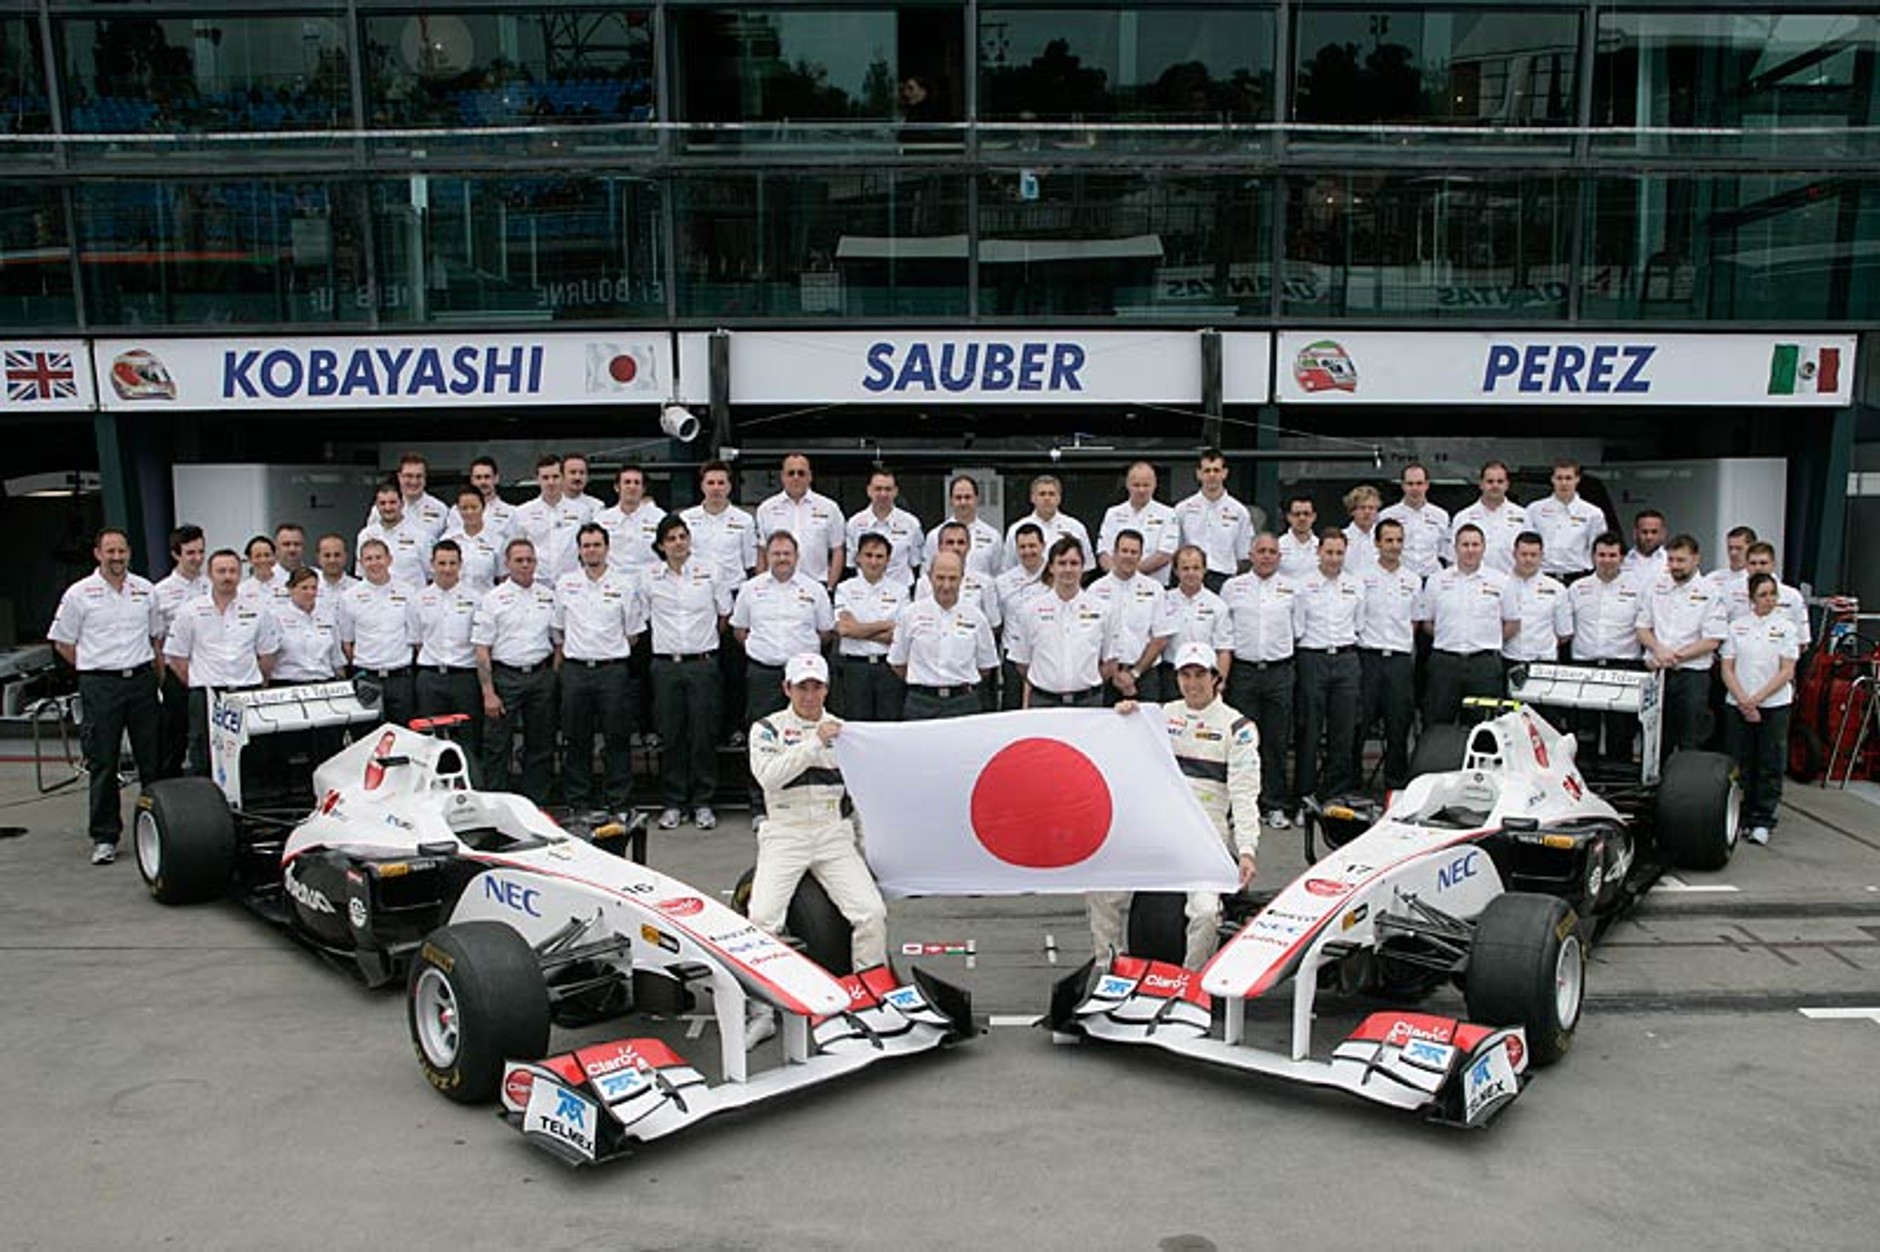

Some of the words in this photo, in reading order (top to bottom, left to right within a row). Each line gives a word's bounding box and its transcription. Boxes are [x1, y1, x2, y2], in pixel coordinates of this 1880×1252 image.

[222, 345, 544, 398] KOBAYASHI
[862, 342, 1086, 392] SAUBER
[1482, 345, 1657, 393] PEREZ
[621, 883, 655, 895] 16
[1438, 851, 1478, 892] NEC
[484, 875, 542, 917] NEC
[586, 1048, 636, 1075] Claro
